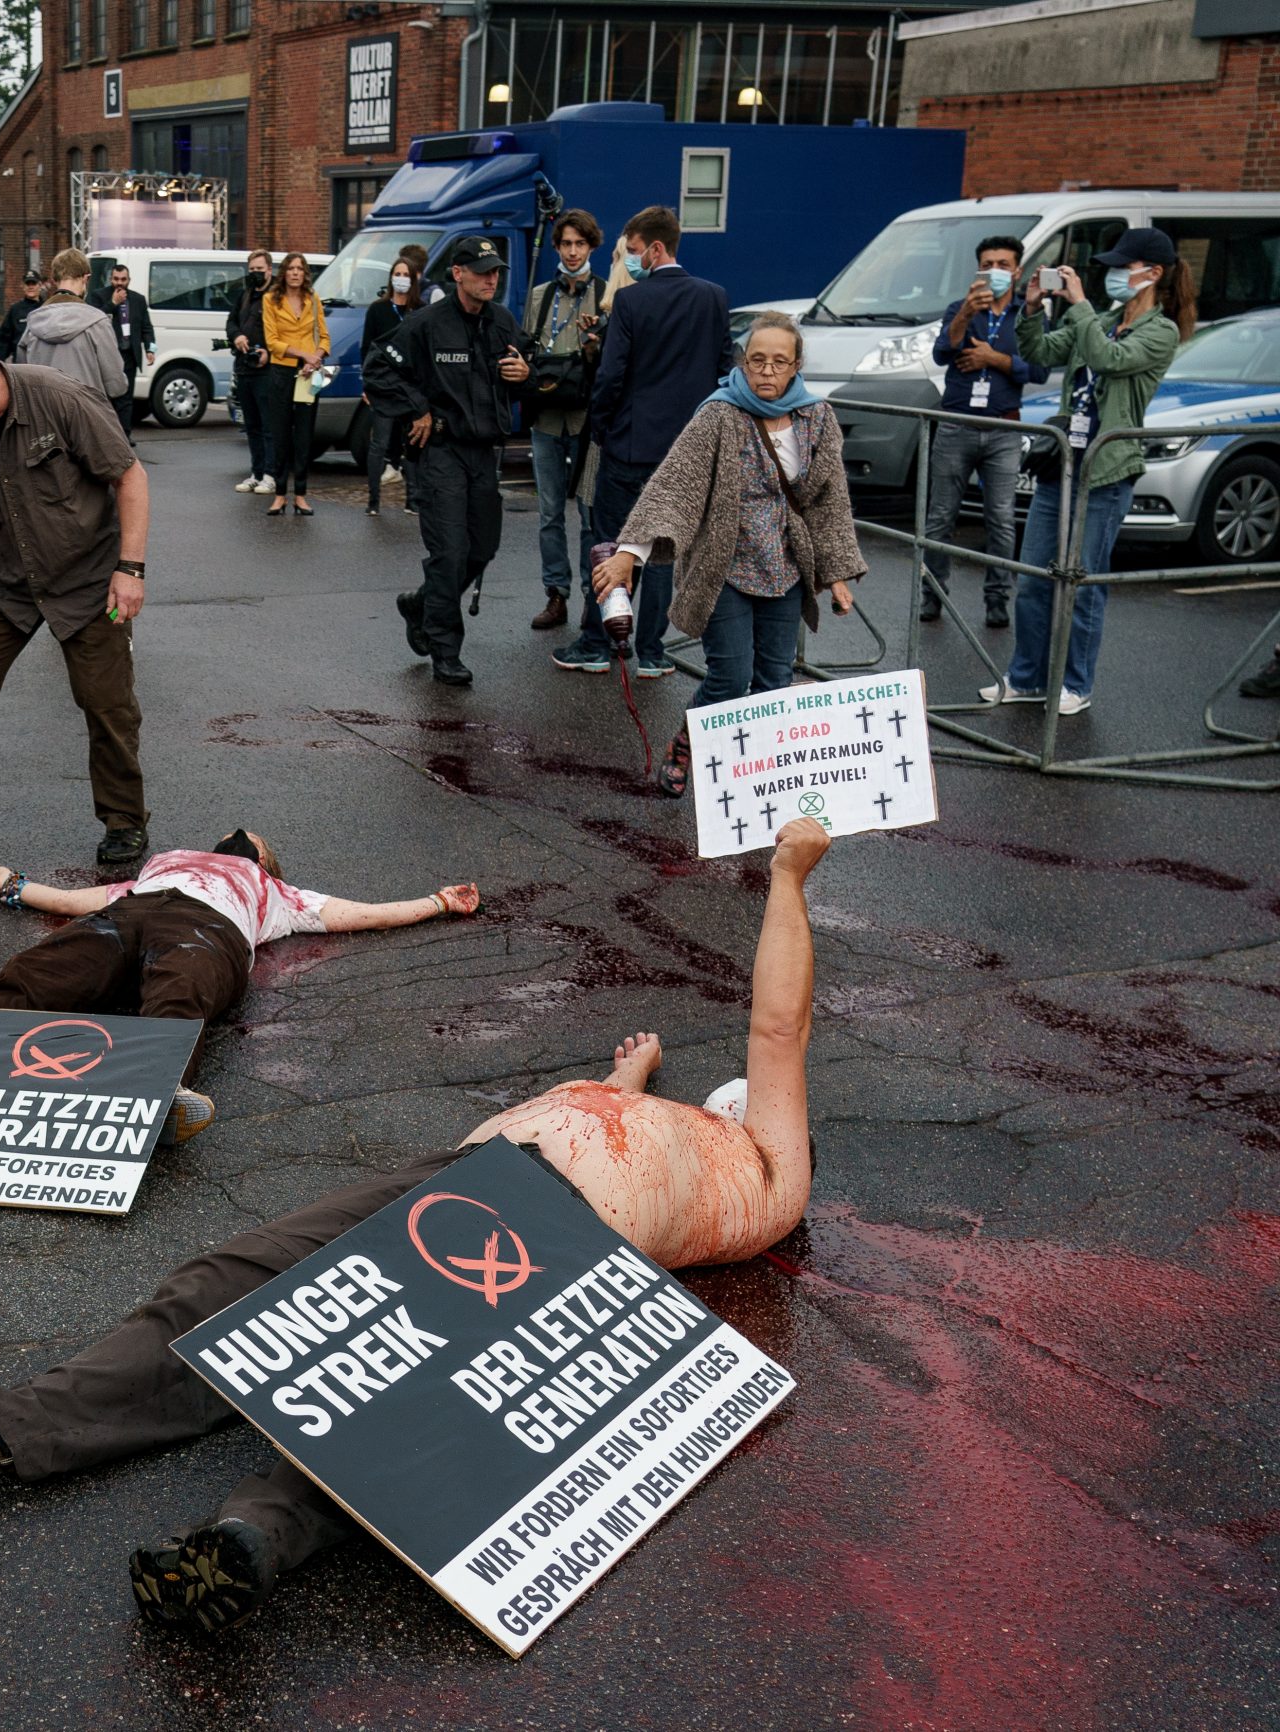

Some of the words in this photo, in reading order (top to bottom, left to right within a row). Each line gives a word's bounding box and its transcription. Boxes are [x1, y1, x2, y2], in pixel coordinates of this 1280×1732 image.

[350, 41, 392, 73] KULTUR
[109, 82, 117, 106] 5
[350, 70, 392, 100] WERFT
[348, 98, 391, 128] GOLLAN
[436, 352, 469, 363] POLIZEI
[700, 700, 791, 731] VERRECHNET,
[797, 694, 833, 711] HERR
[838, 683, 908, 705] LASCHET:
[776, 730, 785, 744] 2
[789, 722, 831, 742] GRAD
[732, 740, 884, 779] KLIMAERWAERMUNG
[753, 774, 804, 797] WAREN
[809, 767, 867, 786] ZUVIEL!
[198, 1254, 405, 1396] HUNGER
[449, 1340, 546, 1414] DER
[513, 1245, 661, 1363] LETZTEN
[271, 1304, 450, 1437] STREIK
[503, 1284, 708, 1454] GENERATION
[464, 1536, 526, 1586] WIR
[507, 1457, 612, 1550] FORDERN
[595, 1428, 644, 1472] EIN
[628, 1343, 740, 1441] SOFORTIGES
[497, 1527, 615, 1637] GESPRÄCH
[597, 1494, 646, 1542] MIT
[631, 1460, 686, 1510] DEN
[668, 1362, 790, 1475] HUNGERNDEN
